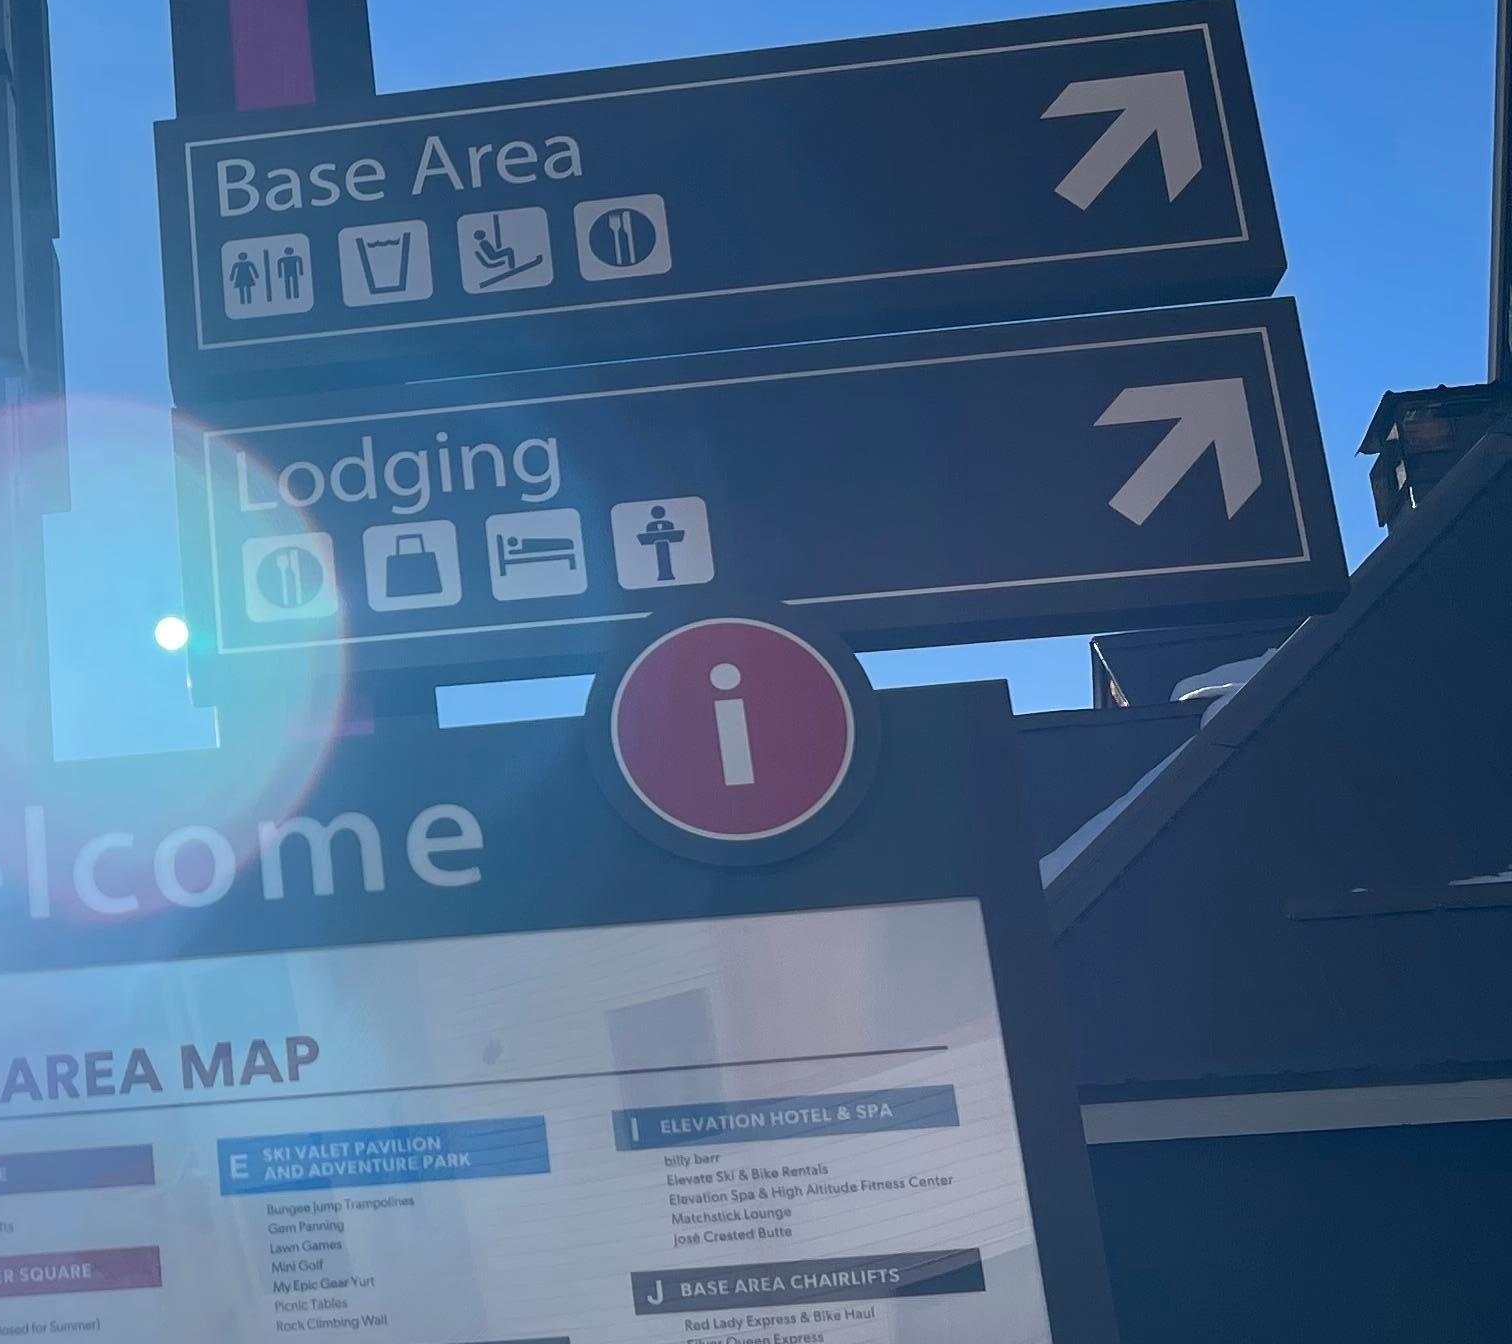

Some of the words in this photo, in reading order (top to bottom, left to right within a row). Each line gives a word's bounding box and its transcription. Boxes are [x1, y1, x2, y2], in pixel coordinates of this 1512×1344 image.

[215, 155, 384, 218] Base
[412, 135, 583, 195] Area
[239, 430, 561, 516] Lodging
[180, 1033, 322, 1090] MAP
[631, 1118, 638, 1141] I
[659, 1113, 766, 1134] ELEVATION
[770, 1107, 833, 1125] HOTEL
[837, 1107, 850, 1120] &
[855, 1103, 893, 1119] SPA
[230, 1154, 248, 1179] E
[263, 1147, 290, 1162] SKI
[296, 1142, 349, 1160] VALET
[355, 1136, 441, 1157] PAVILION
[264, 1164, 304, 1181] AND
[308, 1156, 418, 1178] ADVENTURE
[423, 1152, 471, 1170] PARK
[693, 1152, 720, 1165] barr
[670, 1208, 741, 1226] Matchstick
[743, 1205, 792, 1223] Lounge
[269, 1242, 299, 1254] Lawn
[301, 1239, 342, 1252] Games
[20, 1263, 91, 1284] SQUARE
[271, 1261, 296, 1273] Mini
[298, 1259, 325, 1271] Golf
[646, 1280, 663, 1304] J
[680, 1280, 728, 1297] BASE
[733, 1276, 785, 1293] AREA
[789, 1267, 900, 1289] CHAIRLIFTS
